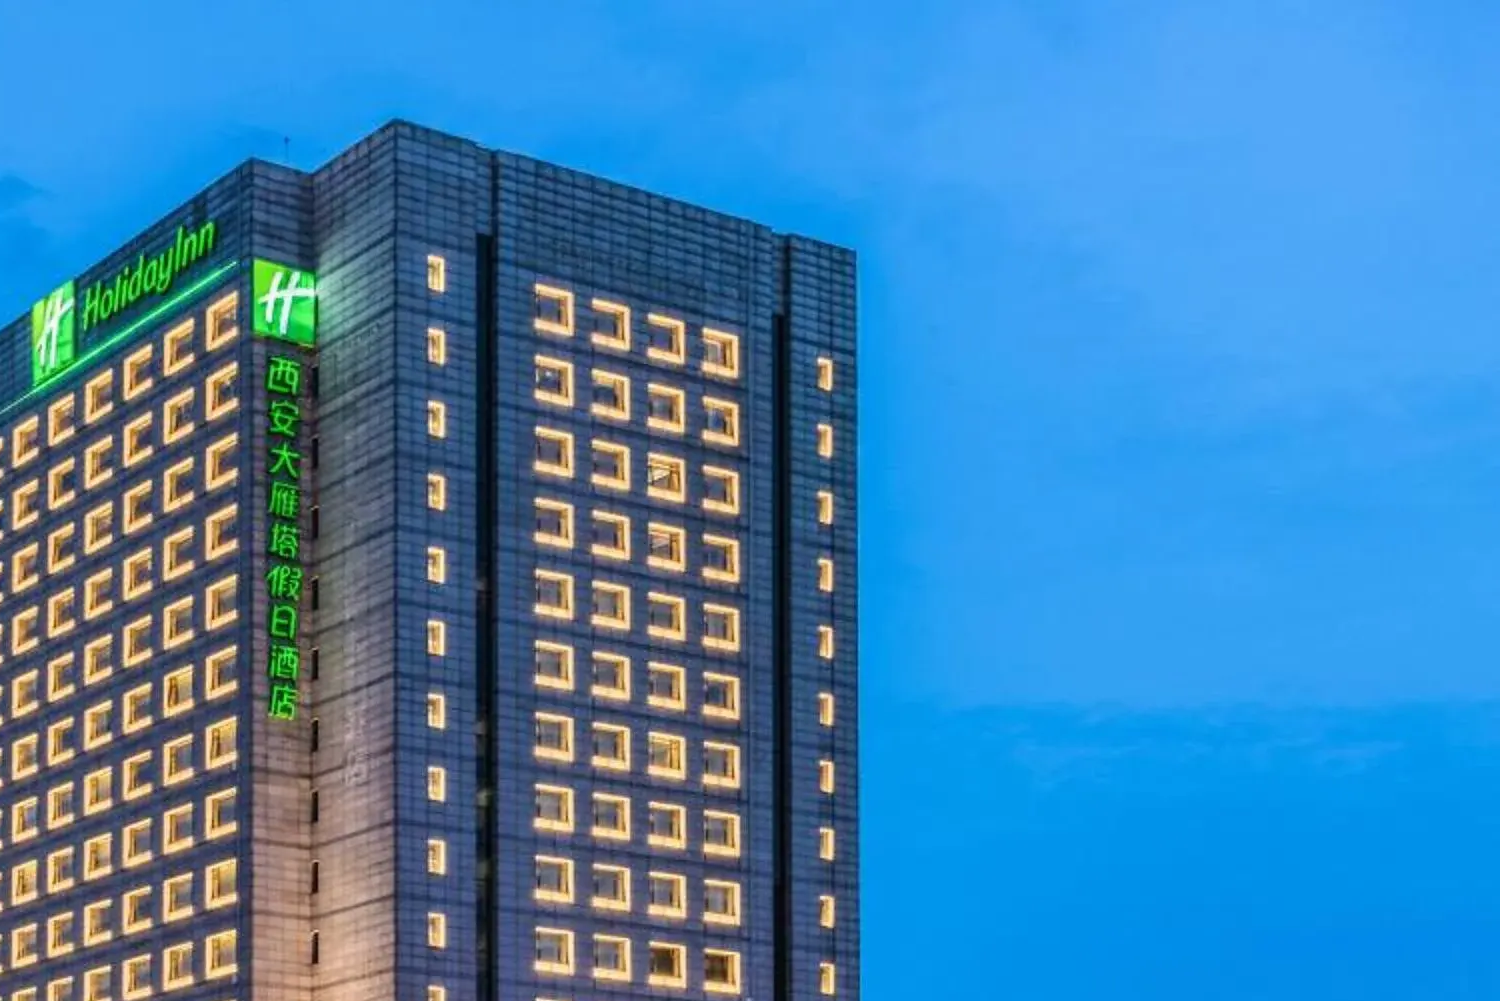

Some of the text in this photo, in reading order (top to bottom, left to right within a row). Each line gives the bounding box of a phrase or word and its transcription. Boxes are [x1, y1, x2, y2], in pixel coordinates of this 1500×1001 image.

[266, 356, 302, 721] 西安大雁塔假日酒店
